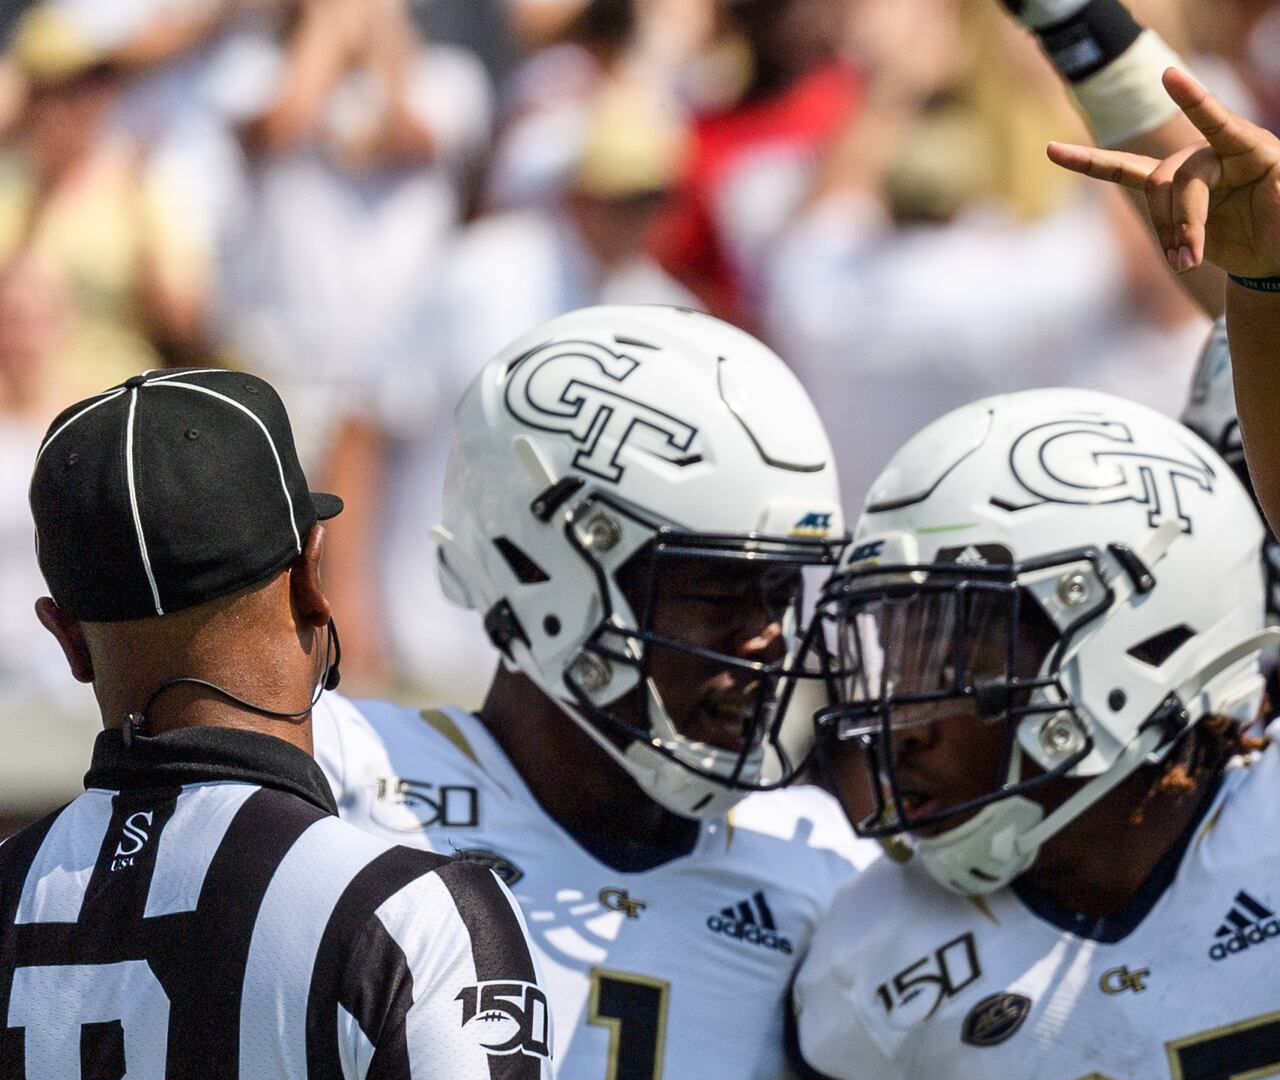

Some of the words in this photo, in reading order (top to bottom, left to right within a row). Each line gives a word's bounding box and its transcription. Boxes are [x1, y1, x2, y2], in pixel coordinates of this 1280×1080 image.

[504, 339, 698, 485] GT
[1009, 419, 1214, 535] GT
[706, 913, 794, 956] adidas
[875, 931, 983, 1023] 150
[1098, 963, 1150, 996] GT
[453, 983, 550, 1058] 150
